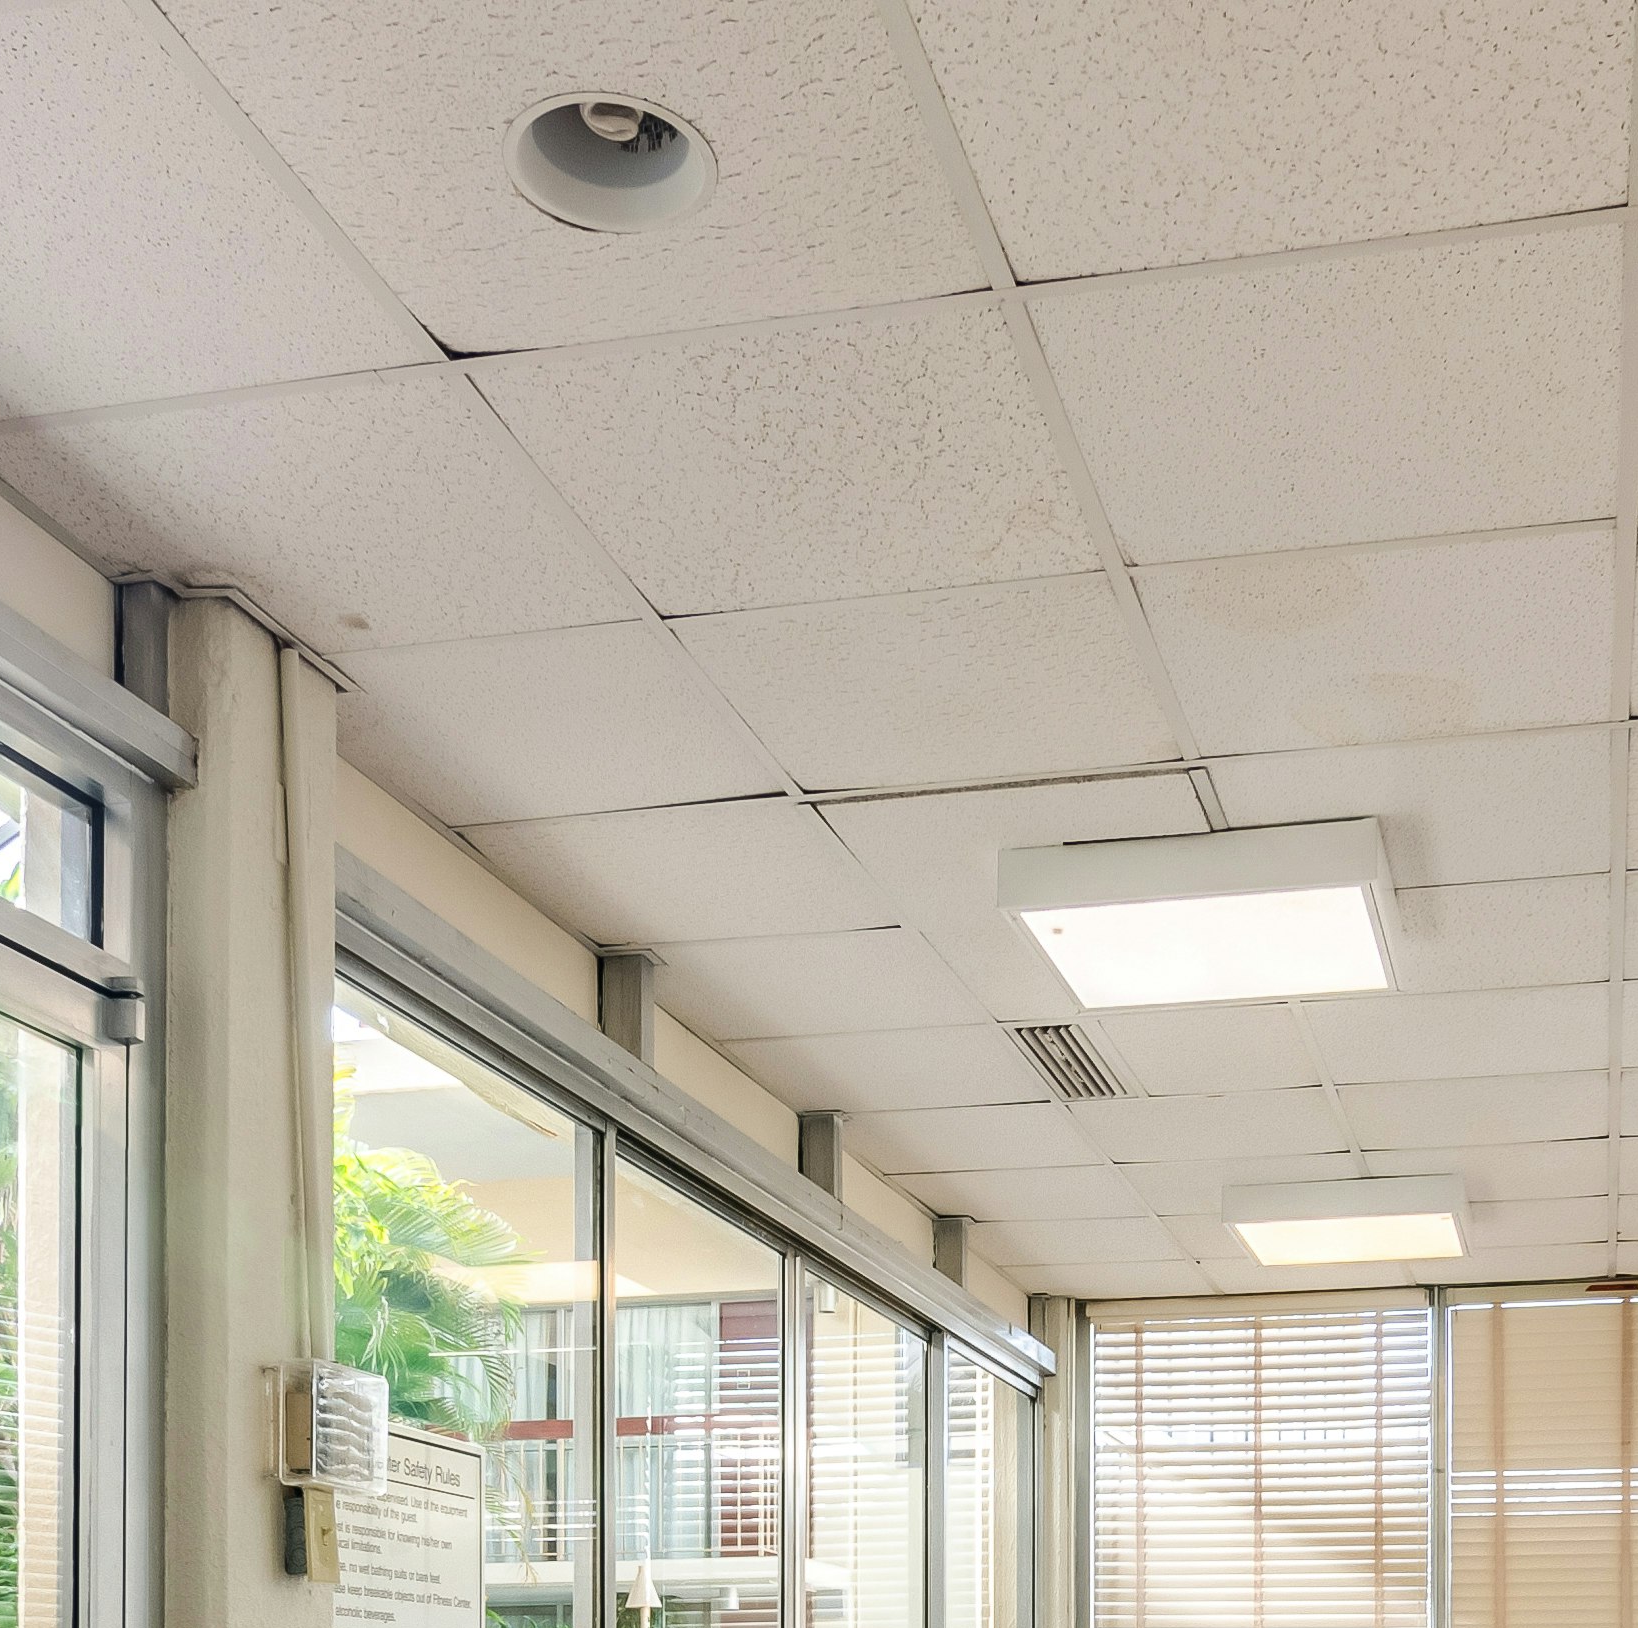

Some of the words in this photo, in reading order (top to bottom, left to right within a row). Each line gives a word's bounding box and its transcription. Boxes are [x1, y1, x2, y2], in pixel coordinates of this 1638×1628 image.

[404, 1458, 433, 1485] Safety
[435, 1466, 461, 1488] Rules
[342, 1501, 381, 1519] responsibility
[383, 1507, 389, 1518] of
[390, 1509, 399, 1520] the
[352, 1525, 386, 1539] responsible
